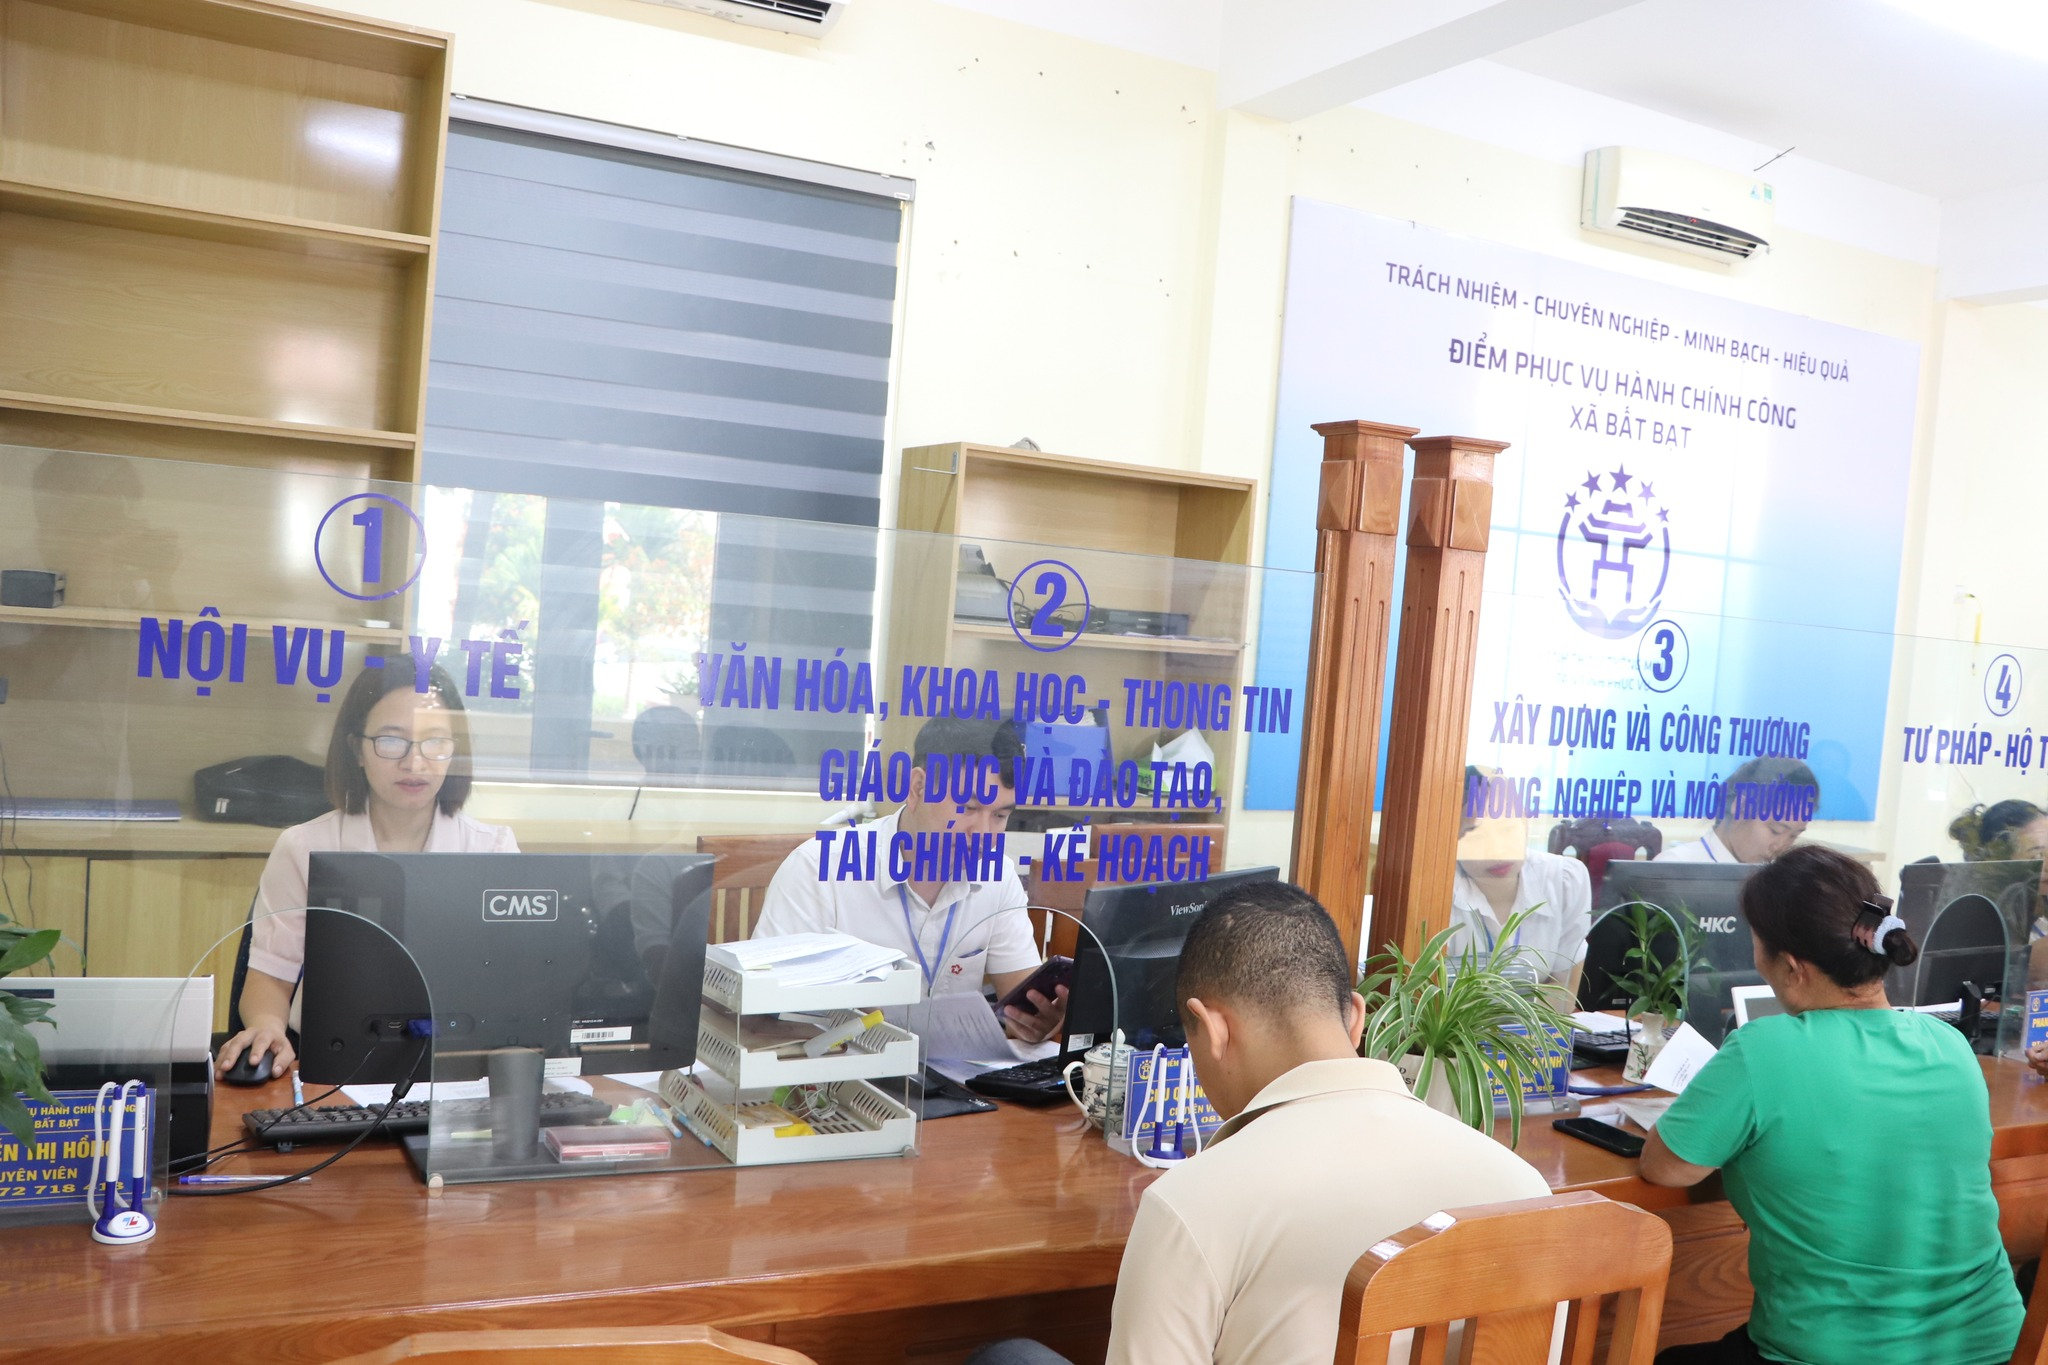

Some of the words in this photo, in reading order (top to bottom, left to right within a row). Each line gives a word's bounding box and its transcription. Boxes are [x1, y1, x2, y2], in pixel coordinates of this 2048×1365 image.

[1386, 262, 1450, 295] TRÁCH
[1456, 277, 1517, 309] NHIỆM
[1534, 295, 1604, 328] CHUYÊN
[1608, 311, 1670, 344] NGHIỆP
[1684, 329, 1726, 355] MINH
[1730, 340, 1770, 365] BẠCH
[1783, 350, 1816, 375] HIỆU
[1820, 359, 1849, 383] QUẢ
[1449, 331, 1507, 373] ĐIỂM
[1515, 351, 1574, 387] PHỤC
[1580, 364, 1608, 397] VỤ
[1615, 370, 1675, 405] HÀNH
[1681, 385, 1741, 419] CHÍNH
[1747, 397, 1797, 429] CÔNG
[1569, 403, 1598, 433] XÃ
[1606, 405, 1647, 440] BẤT
[1652, 421, 1692, 451] BẠT
[353, 507, 383, 583] 1
[1030, 571, 1067, 637] 2
[137, 606, 247, 696] NỘI
[272, 624, 345, 703] VỤ
[364, 655, 385, 668] -
[408, 635, 442, 694] Y
[460, 620, 529, 699] TẾ
[1652, 629, 1675, 681] 3
[698, 641, 782, 710] VĂN
[794, 647, 889, 721] HÓA,
[900, 665, 1001, 721] KHOA
[1013, 672, 1087, 735] HỌC
[1243, 685, 1292, 734] TIN
[1995, 664, 2011, 709] 4
[1489, 694, 1541, 745] XÂY
[1548, 704, 1616, 756] DỰNG
[1626, 704, 1650, 752] VÀ
[1660, 704, 1721, 755] CÔNG
[1729, 716, 1810, 760] THƯƠNG
[1903, 725, 1933, 763] TƯ
[1935, 722, 1992, 765] PHÁP
[2005, 727, 2033, 775] HỘ
[819, 739, 912, 802] GIÁO
[924, 753, 1000, 814] DỤC
[1013, 746, 1056, 806] VÀ
[1068, 749, 1139, 808] ĐÀO
[1150, 761, 1222, 821] TẠO,
[1466, 767, 1541, 819] NÔNG
[1552, 770, 1642, 828] NGHIỆP
[1651, 770, 1676, 819] VÀ
[1683, 773, 1727, 820] MÔI
[1734, 773, 1815, 822] TRƯỜNG
[815, 818, 877, 882] TÀI
[889, 820, 1005, 882] CHÍNH
[1041, 815, 1091, 882] KẾ
[1097, 834, 1211, 894] HOẠCH
[489, 895, 548, 916] CMS
[1170, 901, 1208, 916] ViewSon
[1698, 915, 1737, 934] HKC
[34, 1117, 55, 1128] BẤT
[59, 1118, 80, 1129] BẠT
[41, 1105, 70, 1115] HÀNH
[34, 1183, 76, 1194] 718
[42, 1165, 78, 1180] VIÊN
